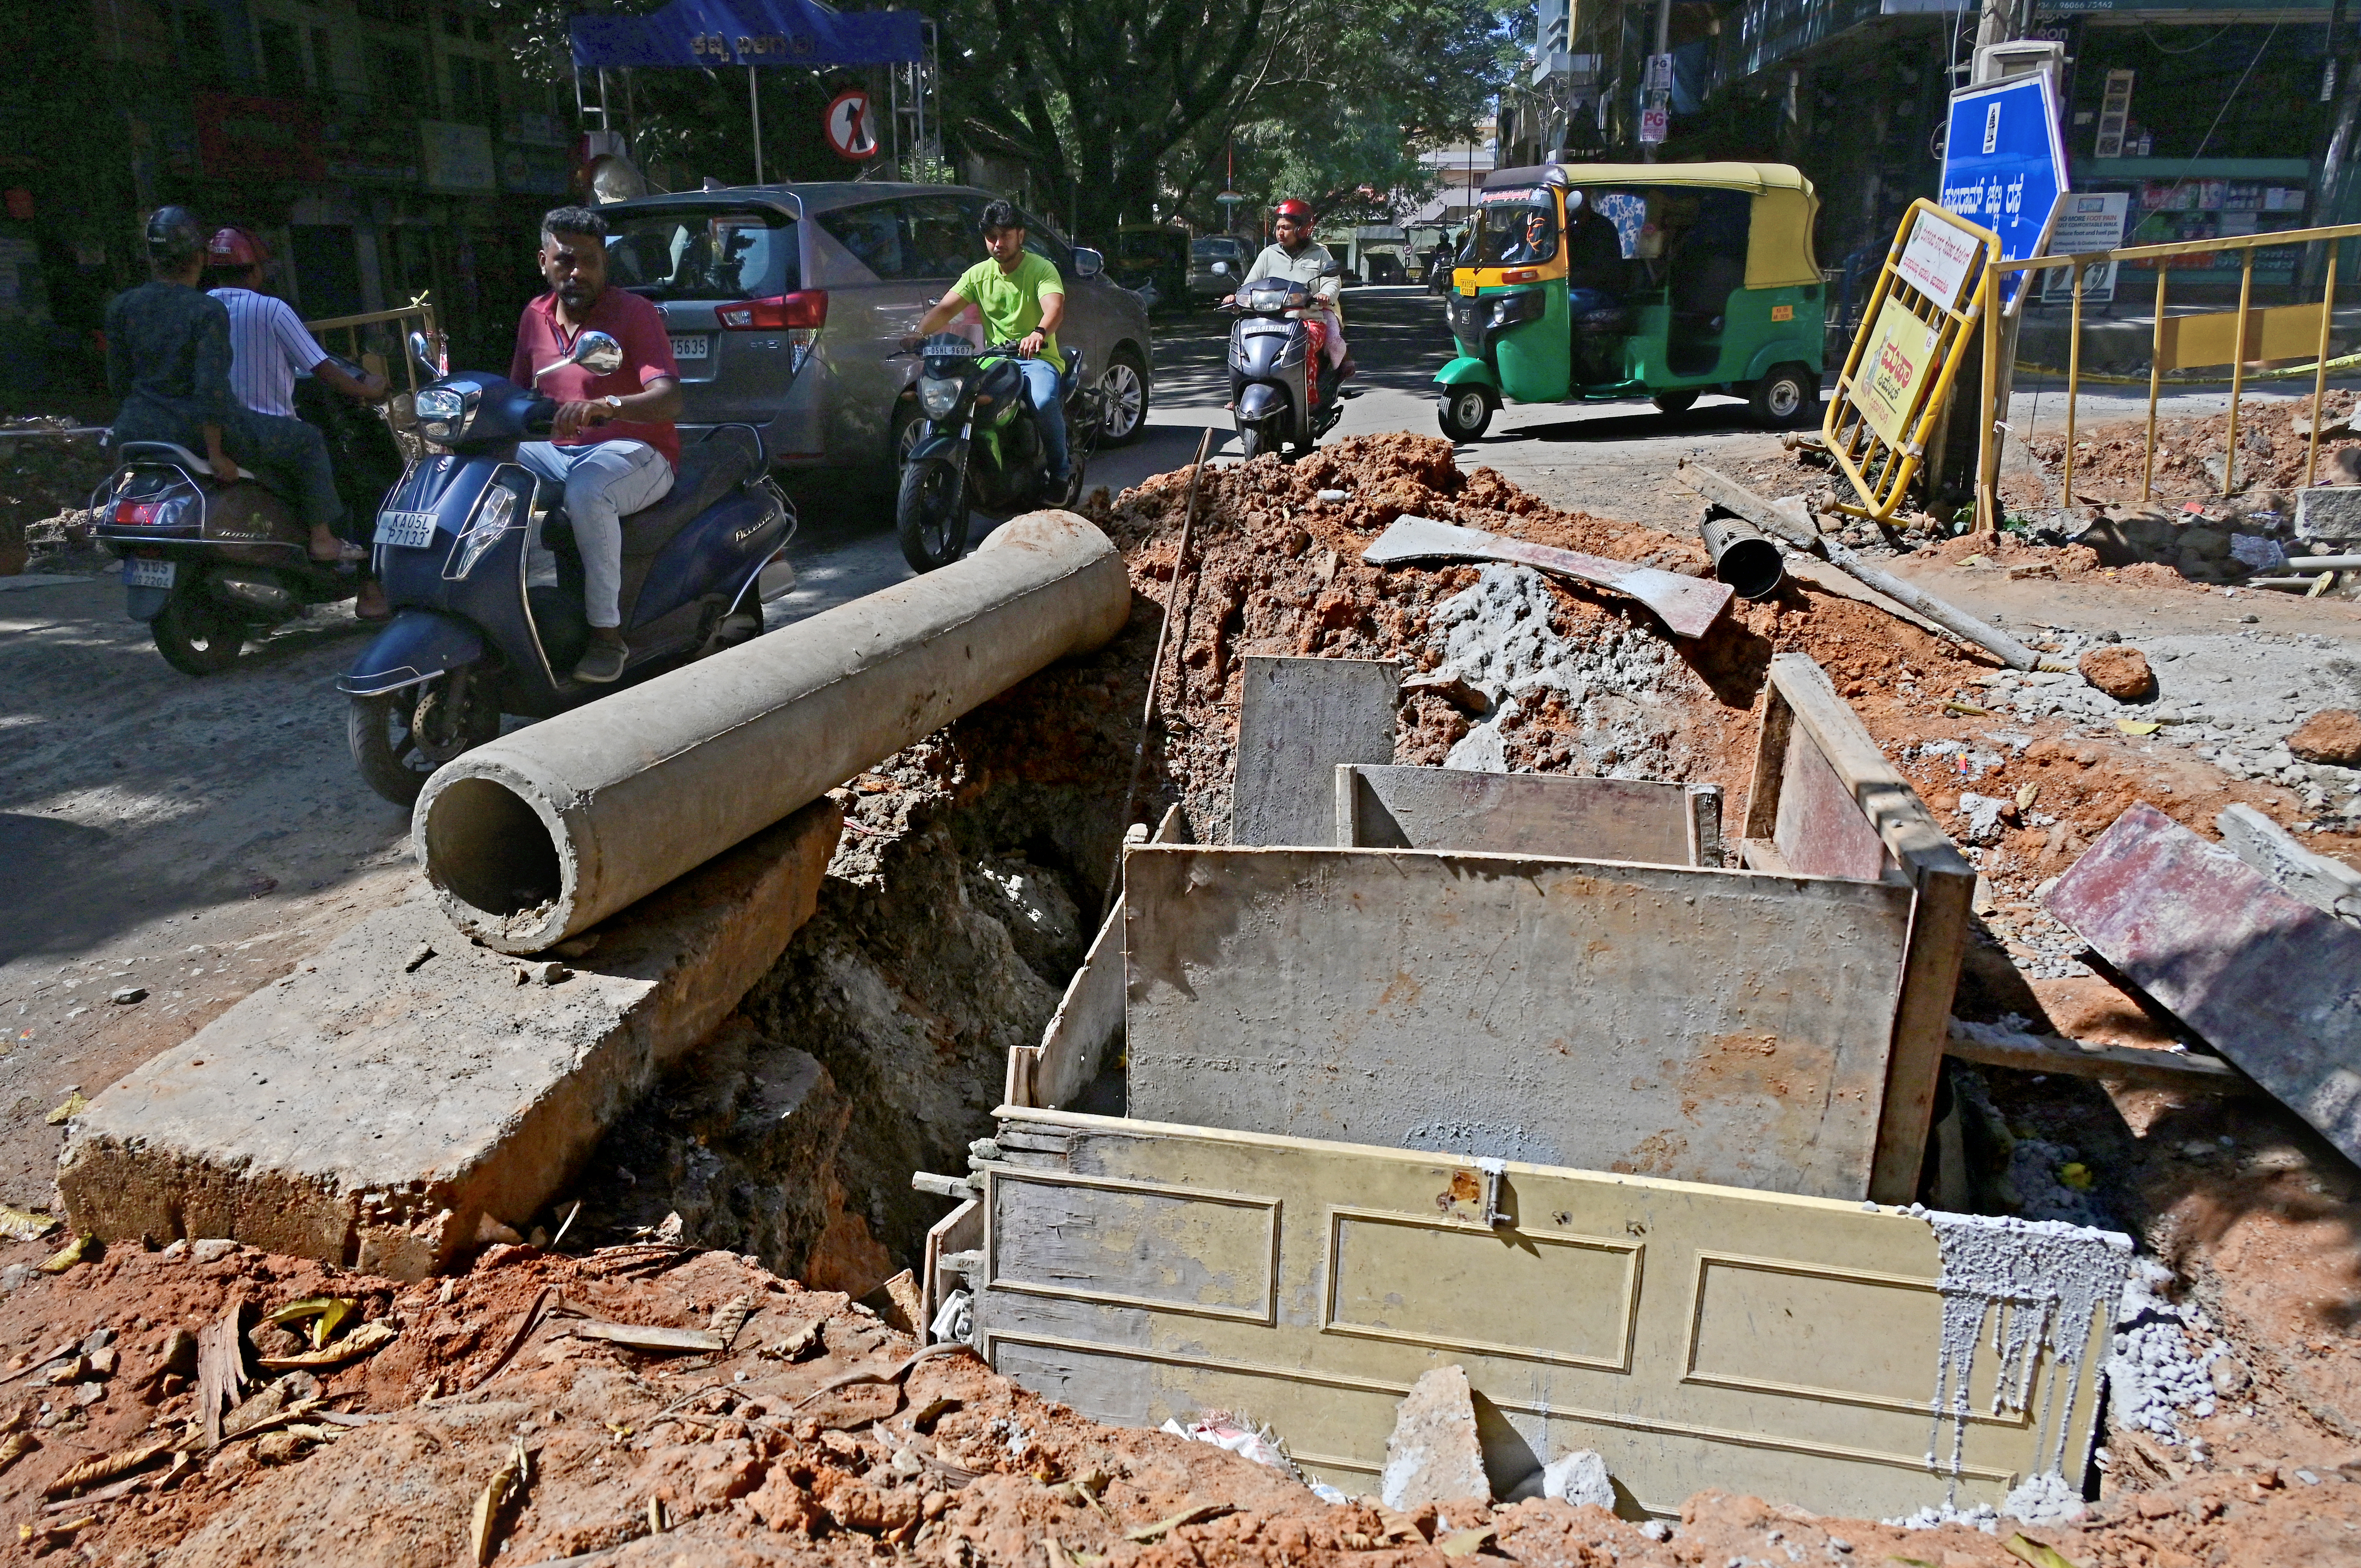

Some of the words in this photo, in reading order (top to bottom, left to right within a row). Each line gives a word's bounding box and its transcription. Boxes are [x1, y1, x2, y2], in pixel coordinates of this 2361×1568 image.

[1652, 60, 1667, 68] PG
[1644, 111, 1664, 127] PG
[1881, 339, 1913, 388] ಮಹಾ
[393, 513, 428, 530] KA05L
[387, 528, 425, 546] P7133
